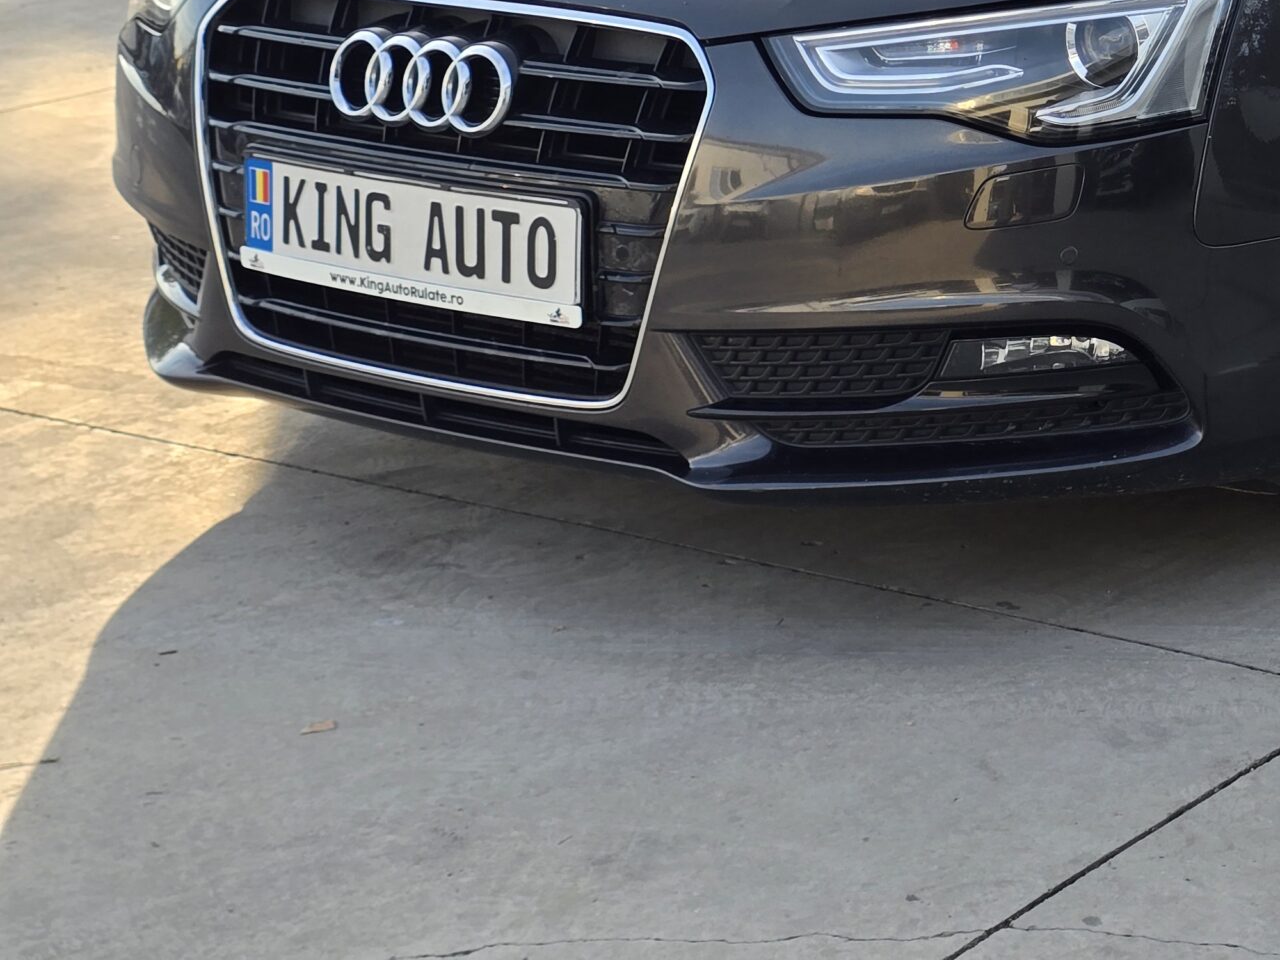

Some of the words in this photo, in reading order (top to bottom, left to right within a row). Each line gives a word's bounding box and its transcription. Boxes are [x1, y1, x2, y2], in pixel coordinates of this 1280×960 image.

[250, 211, 271, 240] RO
[283, 175, 392, 264] KING
[423, 201, 558, 290] AUTO
[329, 271, 465, 306] www.KingAutoRulate.ro
